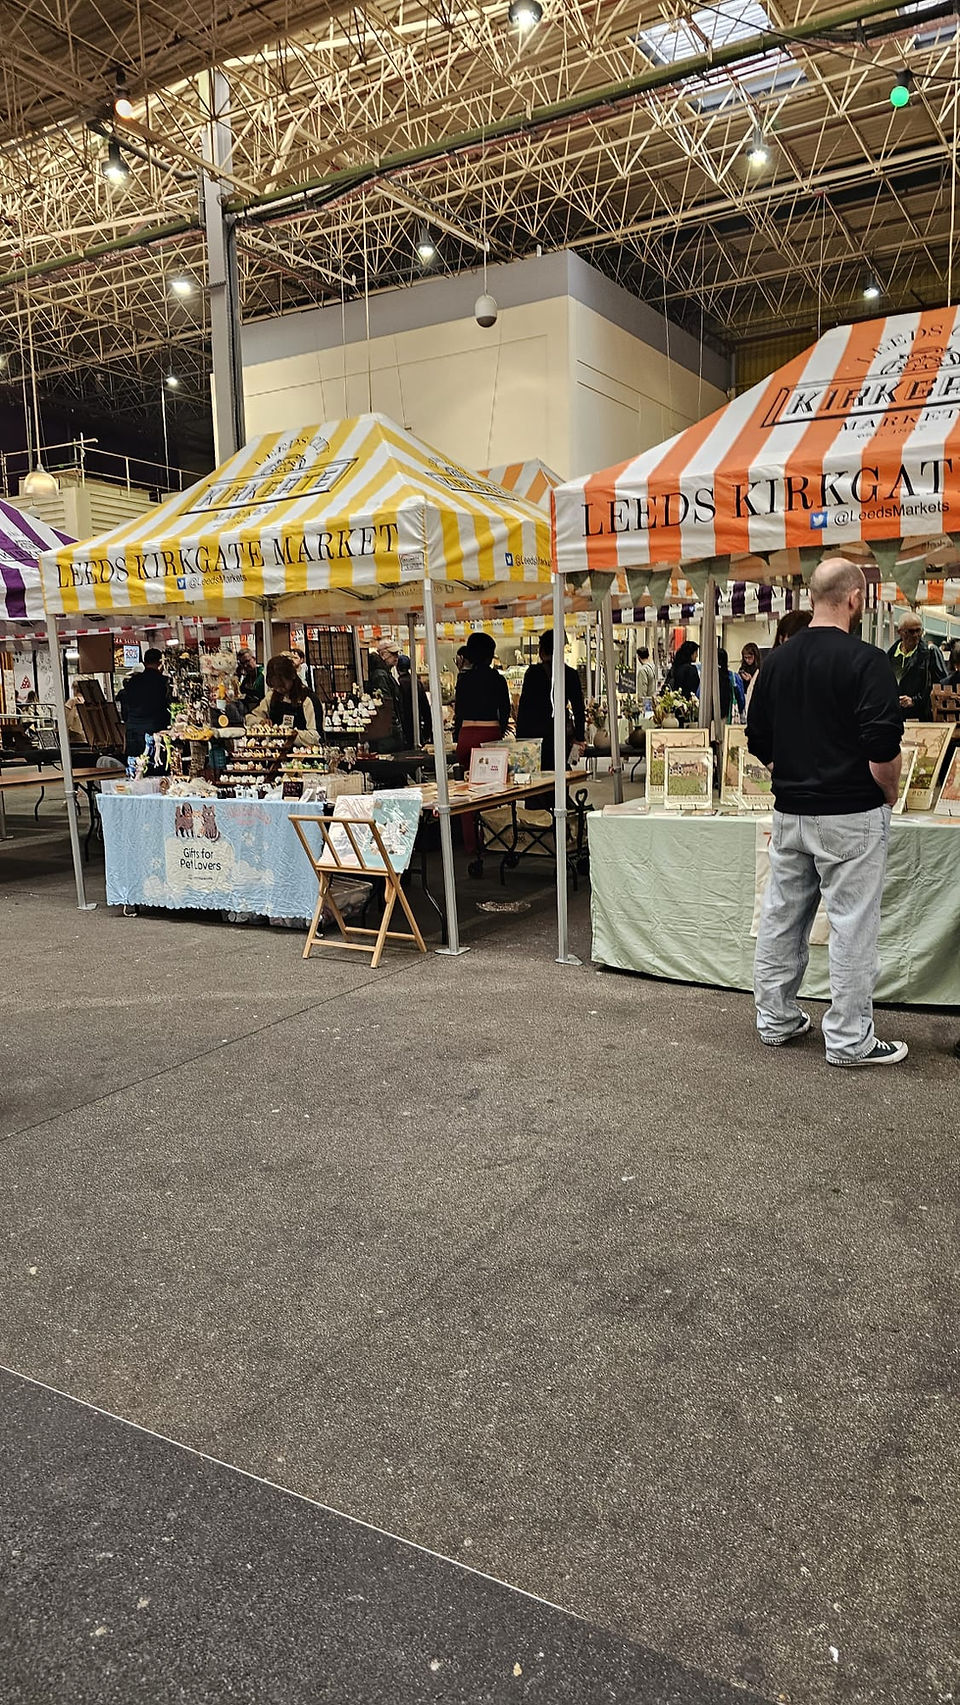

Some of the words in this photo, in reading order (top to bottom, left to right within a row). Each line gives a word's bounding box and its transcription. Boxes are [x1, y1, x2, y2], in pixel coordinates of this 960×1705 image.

[856, 325, 943, 363] LEEDS
[581, 487, 716, 537] LEEDS
[731, 457, 960, 520] KIRKGAT
[833, 500, 950, 527] @LeedsMarkets
[56, 556, 130, 589] LEEDS
[134, 539, 264, 581] KIRKGATE
[273, 523, 399, 567] MARKET
[183, 847, 200, 859] Gifts
[201, 847, 214, 859] for
